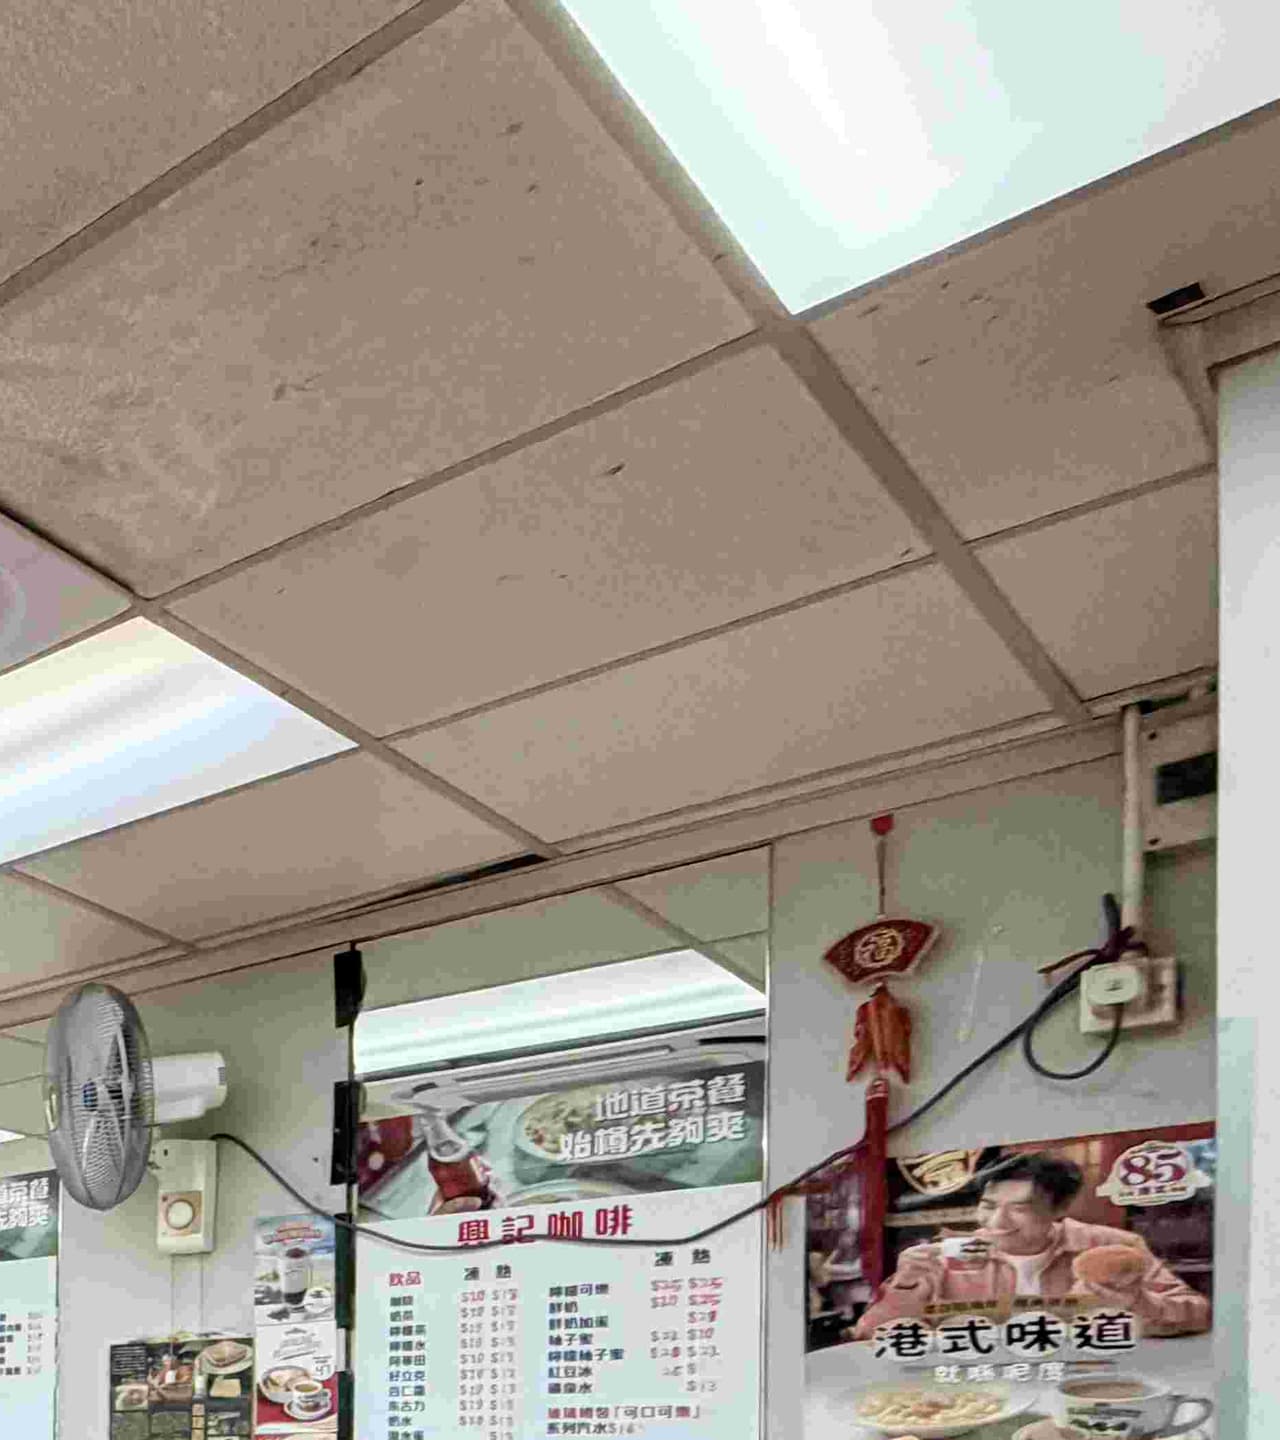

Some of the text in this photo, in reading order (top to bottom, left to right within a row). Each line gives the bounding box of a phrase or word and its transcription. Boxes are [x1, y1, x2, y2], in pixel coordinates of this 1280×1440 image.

[1120, 1150, 1187, 1185] 85
[457, 1203, 633, 1246] 興記咖啡
[389, 1271, 422, 1287] 飲品
[874, 1311, 1137, 1358] 港式味道
